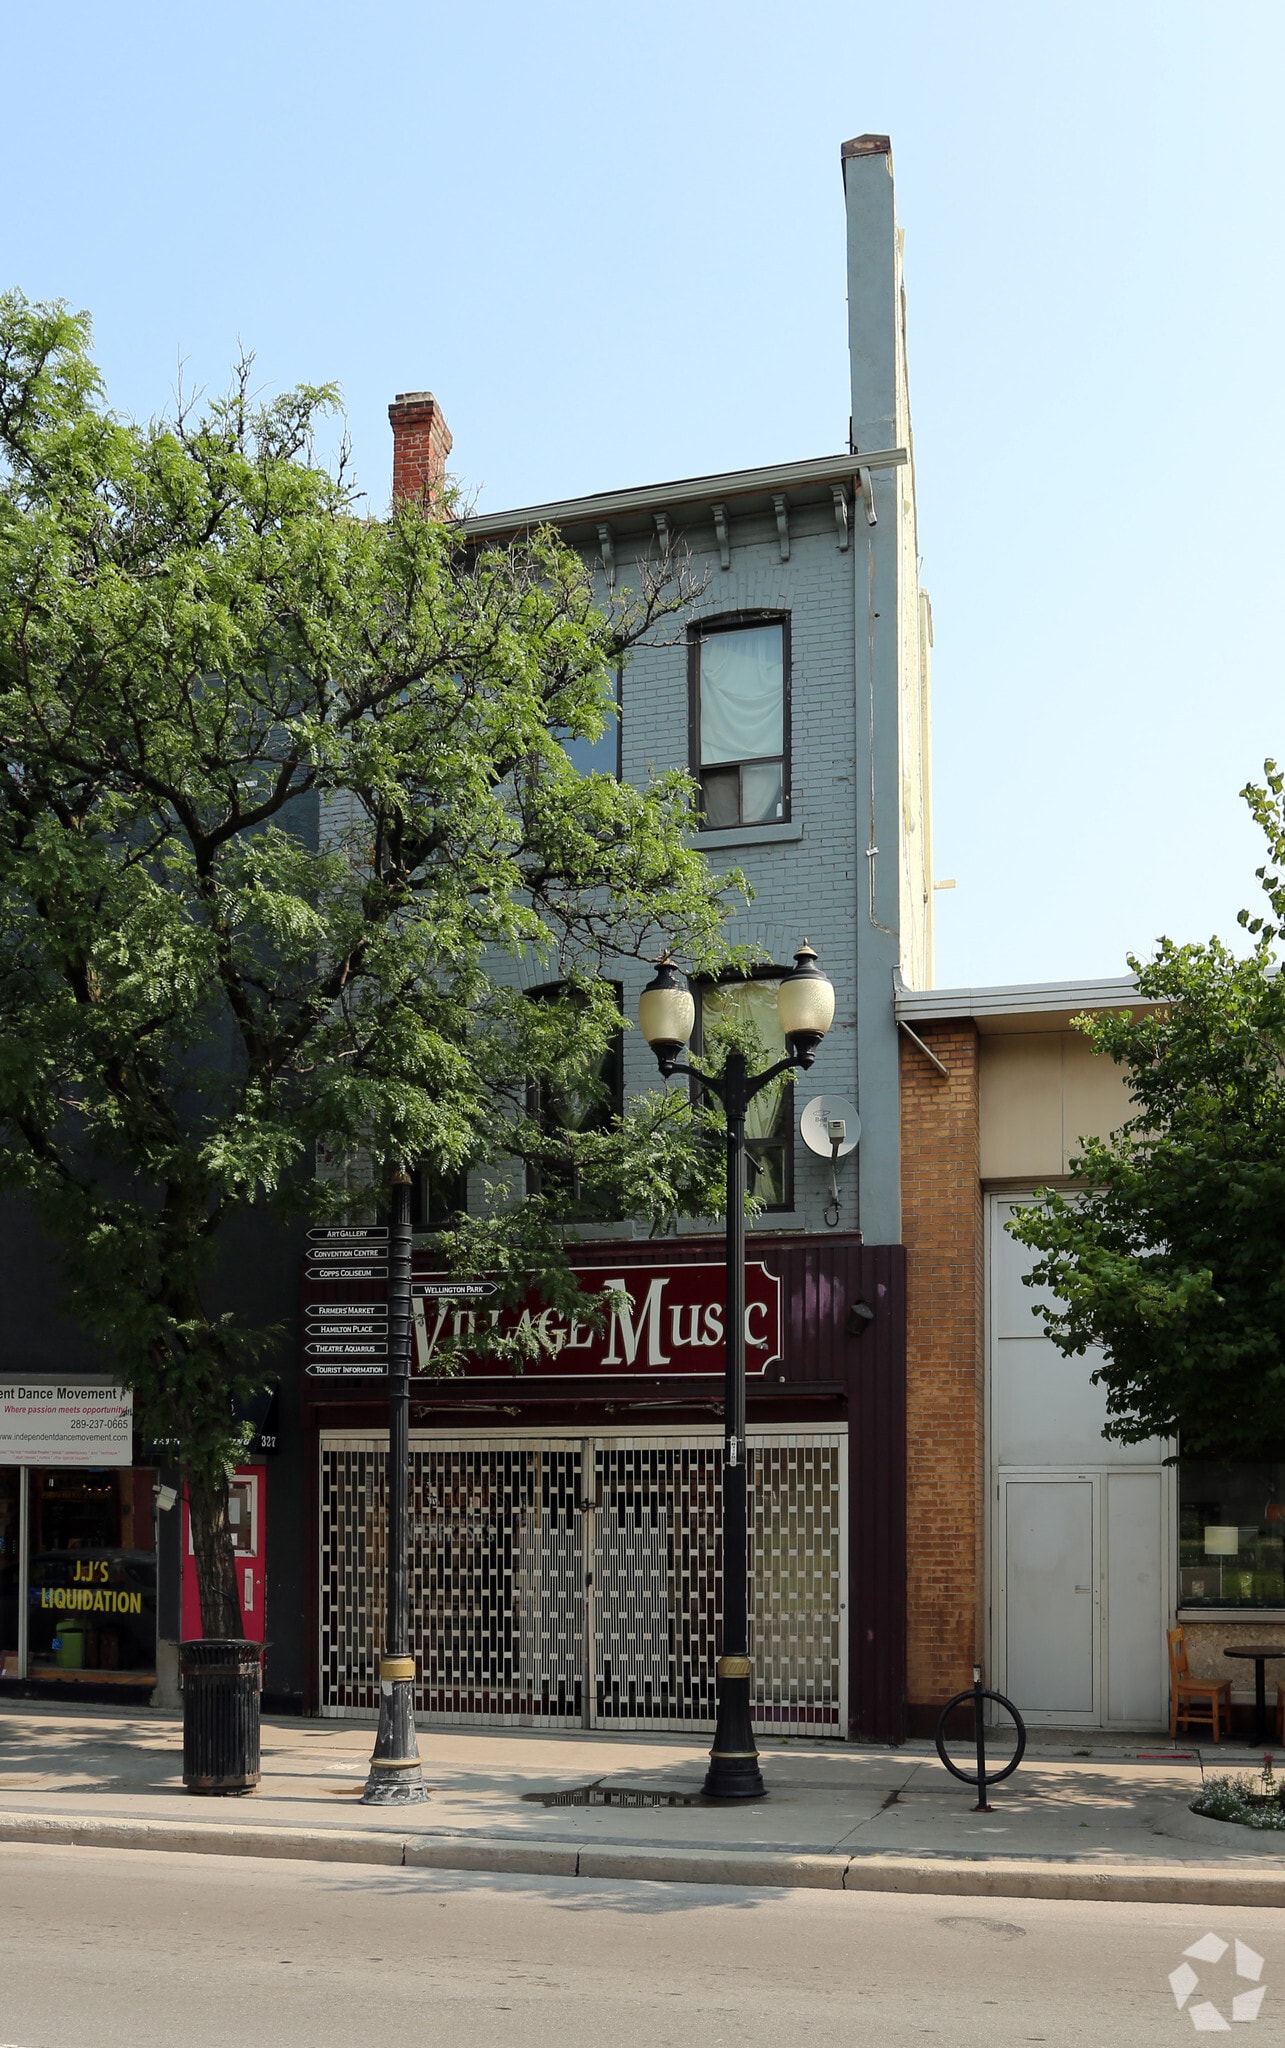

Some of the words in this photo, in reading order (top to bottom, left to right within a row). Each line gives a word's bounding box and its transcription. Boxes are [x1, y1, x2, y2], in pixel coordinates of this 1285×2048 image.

[326, 1230, 340, 1238] ART
[340, 1230, 368, 1238] GALLERY
[314, 1250, 353, 1258] CONVENTION
[353, 1249, 379, 1257] CENTRE
[319, 1270, 340, 1278] COPPS
[340, 1269, 372, 1277] COLISEUM
[424, 1286, 465, 1294] WELLINGTON
[466, 1285, 484, 1293] PARK
[347, 1306, 375, 1314] MARKET
[600, 1277, 768, 1366] MUSC
[352, 1325, 373, 1333] PLACE
[315, 1344, 344, 1352] THEATRE
[344, 1344, 376, 1352] AQUARIUS
[315, 1366, 342, 1374] TOURIST
[342, 1366, 383, 1374] INFORMATION
[18, 1387, 53, 1399] Dance
[56, 1388, 117, 1400] Movement
[4, 1405, 26, 1414] Where
[28, 1405, 55, 1415] passion
[58, 1406, 80, 1414] meets
[70, 1419, 129, 1430] 289-237-0665
[261, 1435, 277, 1448] 327
[407, 1523, 495, 1542] NTERPRISES
[73, 1560, 109, 1582] J.J'S
[41, 1587, 142, 1614] LIQUIDATION
